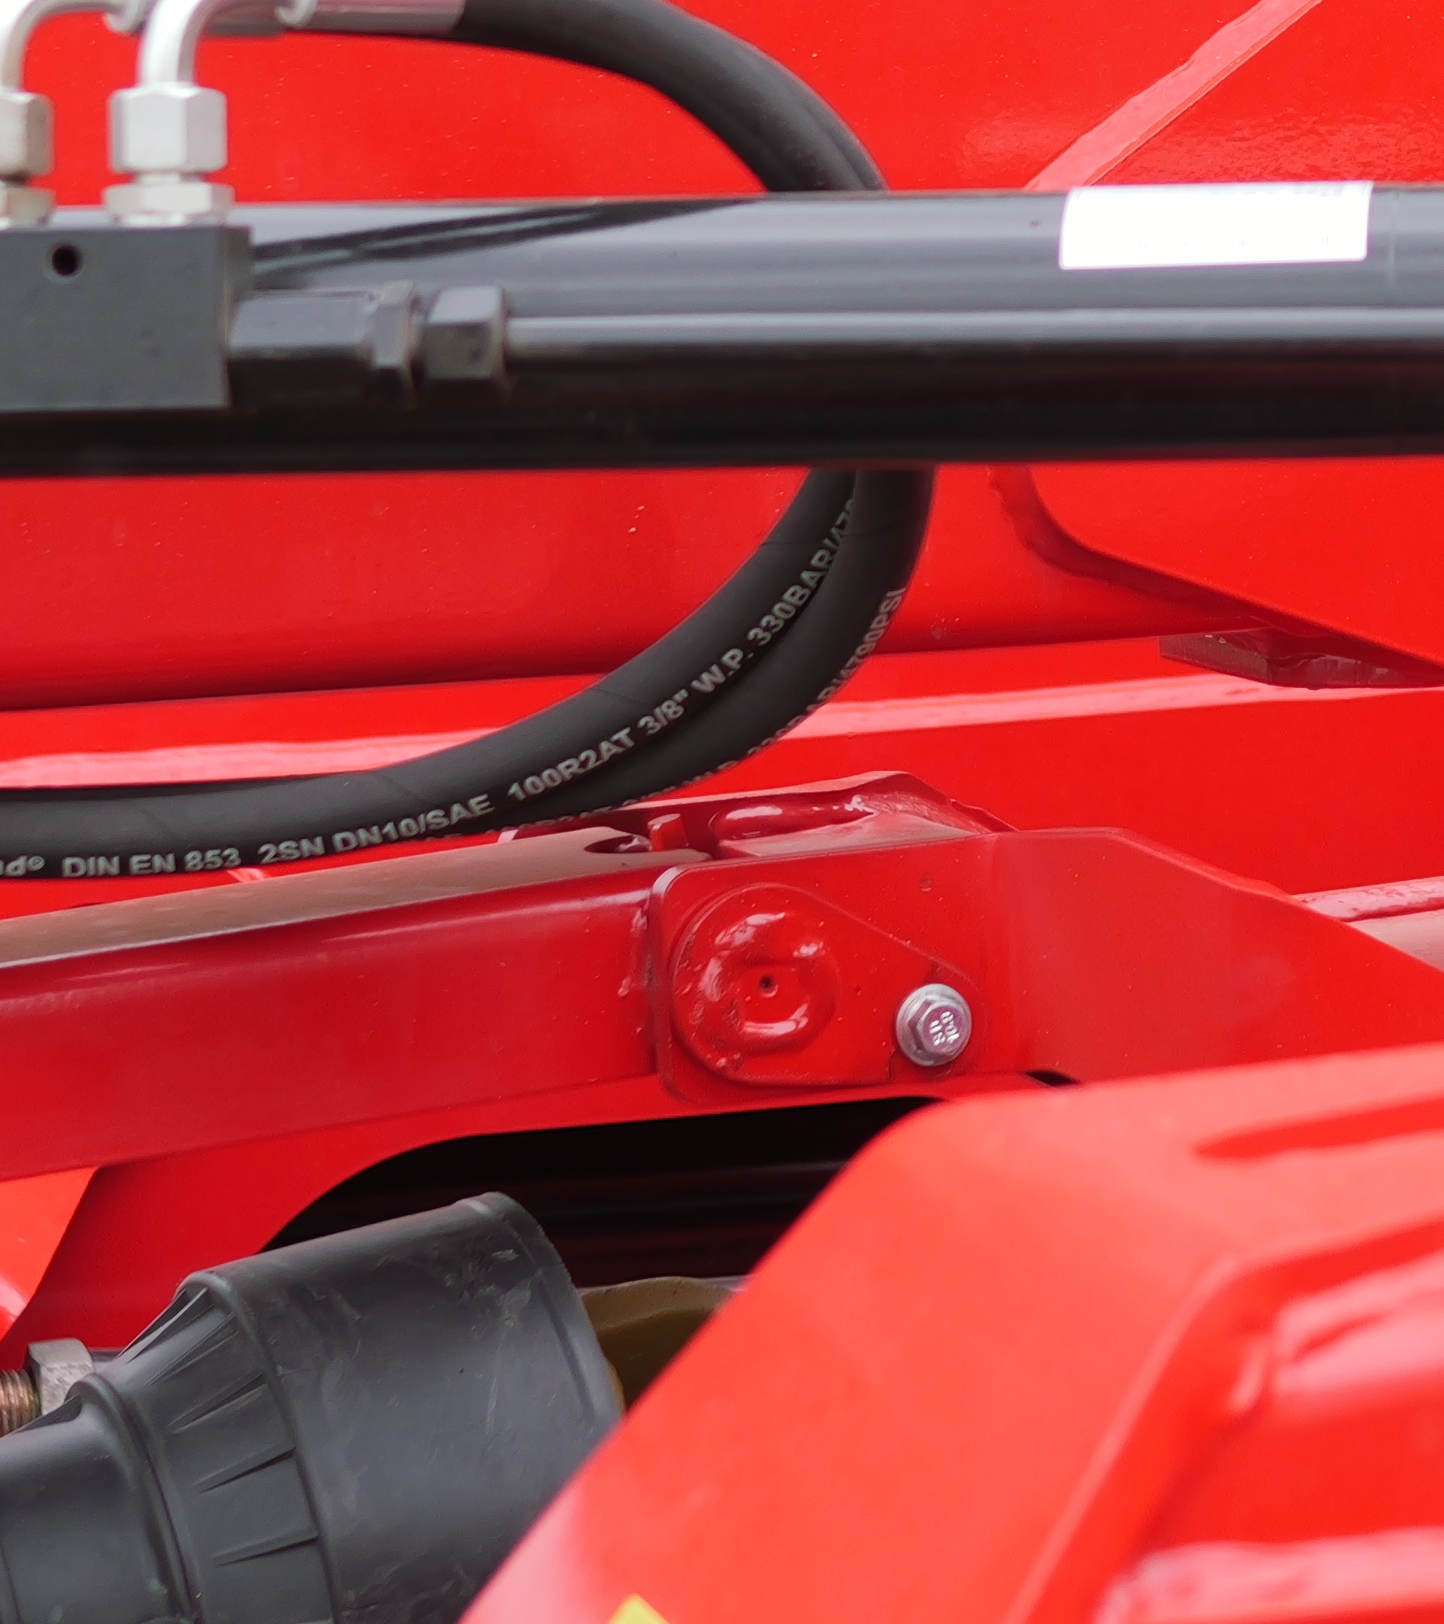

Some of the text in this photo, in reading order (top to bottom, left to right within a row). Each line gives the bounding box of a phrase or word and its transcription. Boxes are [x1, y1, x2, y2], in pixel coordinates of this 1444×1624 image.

[62, 855, 120, 877] DIN
[129, 853, 177, 875] EN
[184, 847, 241, 871] 853
[257, 835, 326, 865] 2SN
[332, 794, 496, 852] DN10/SAE
[507, 727, 636, 801] 100R2AT
[637, 688, 690, 736] 3/8"
